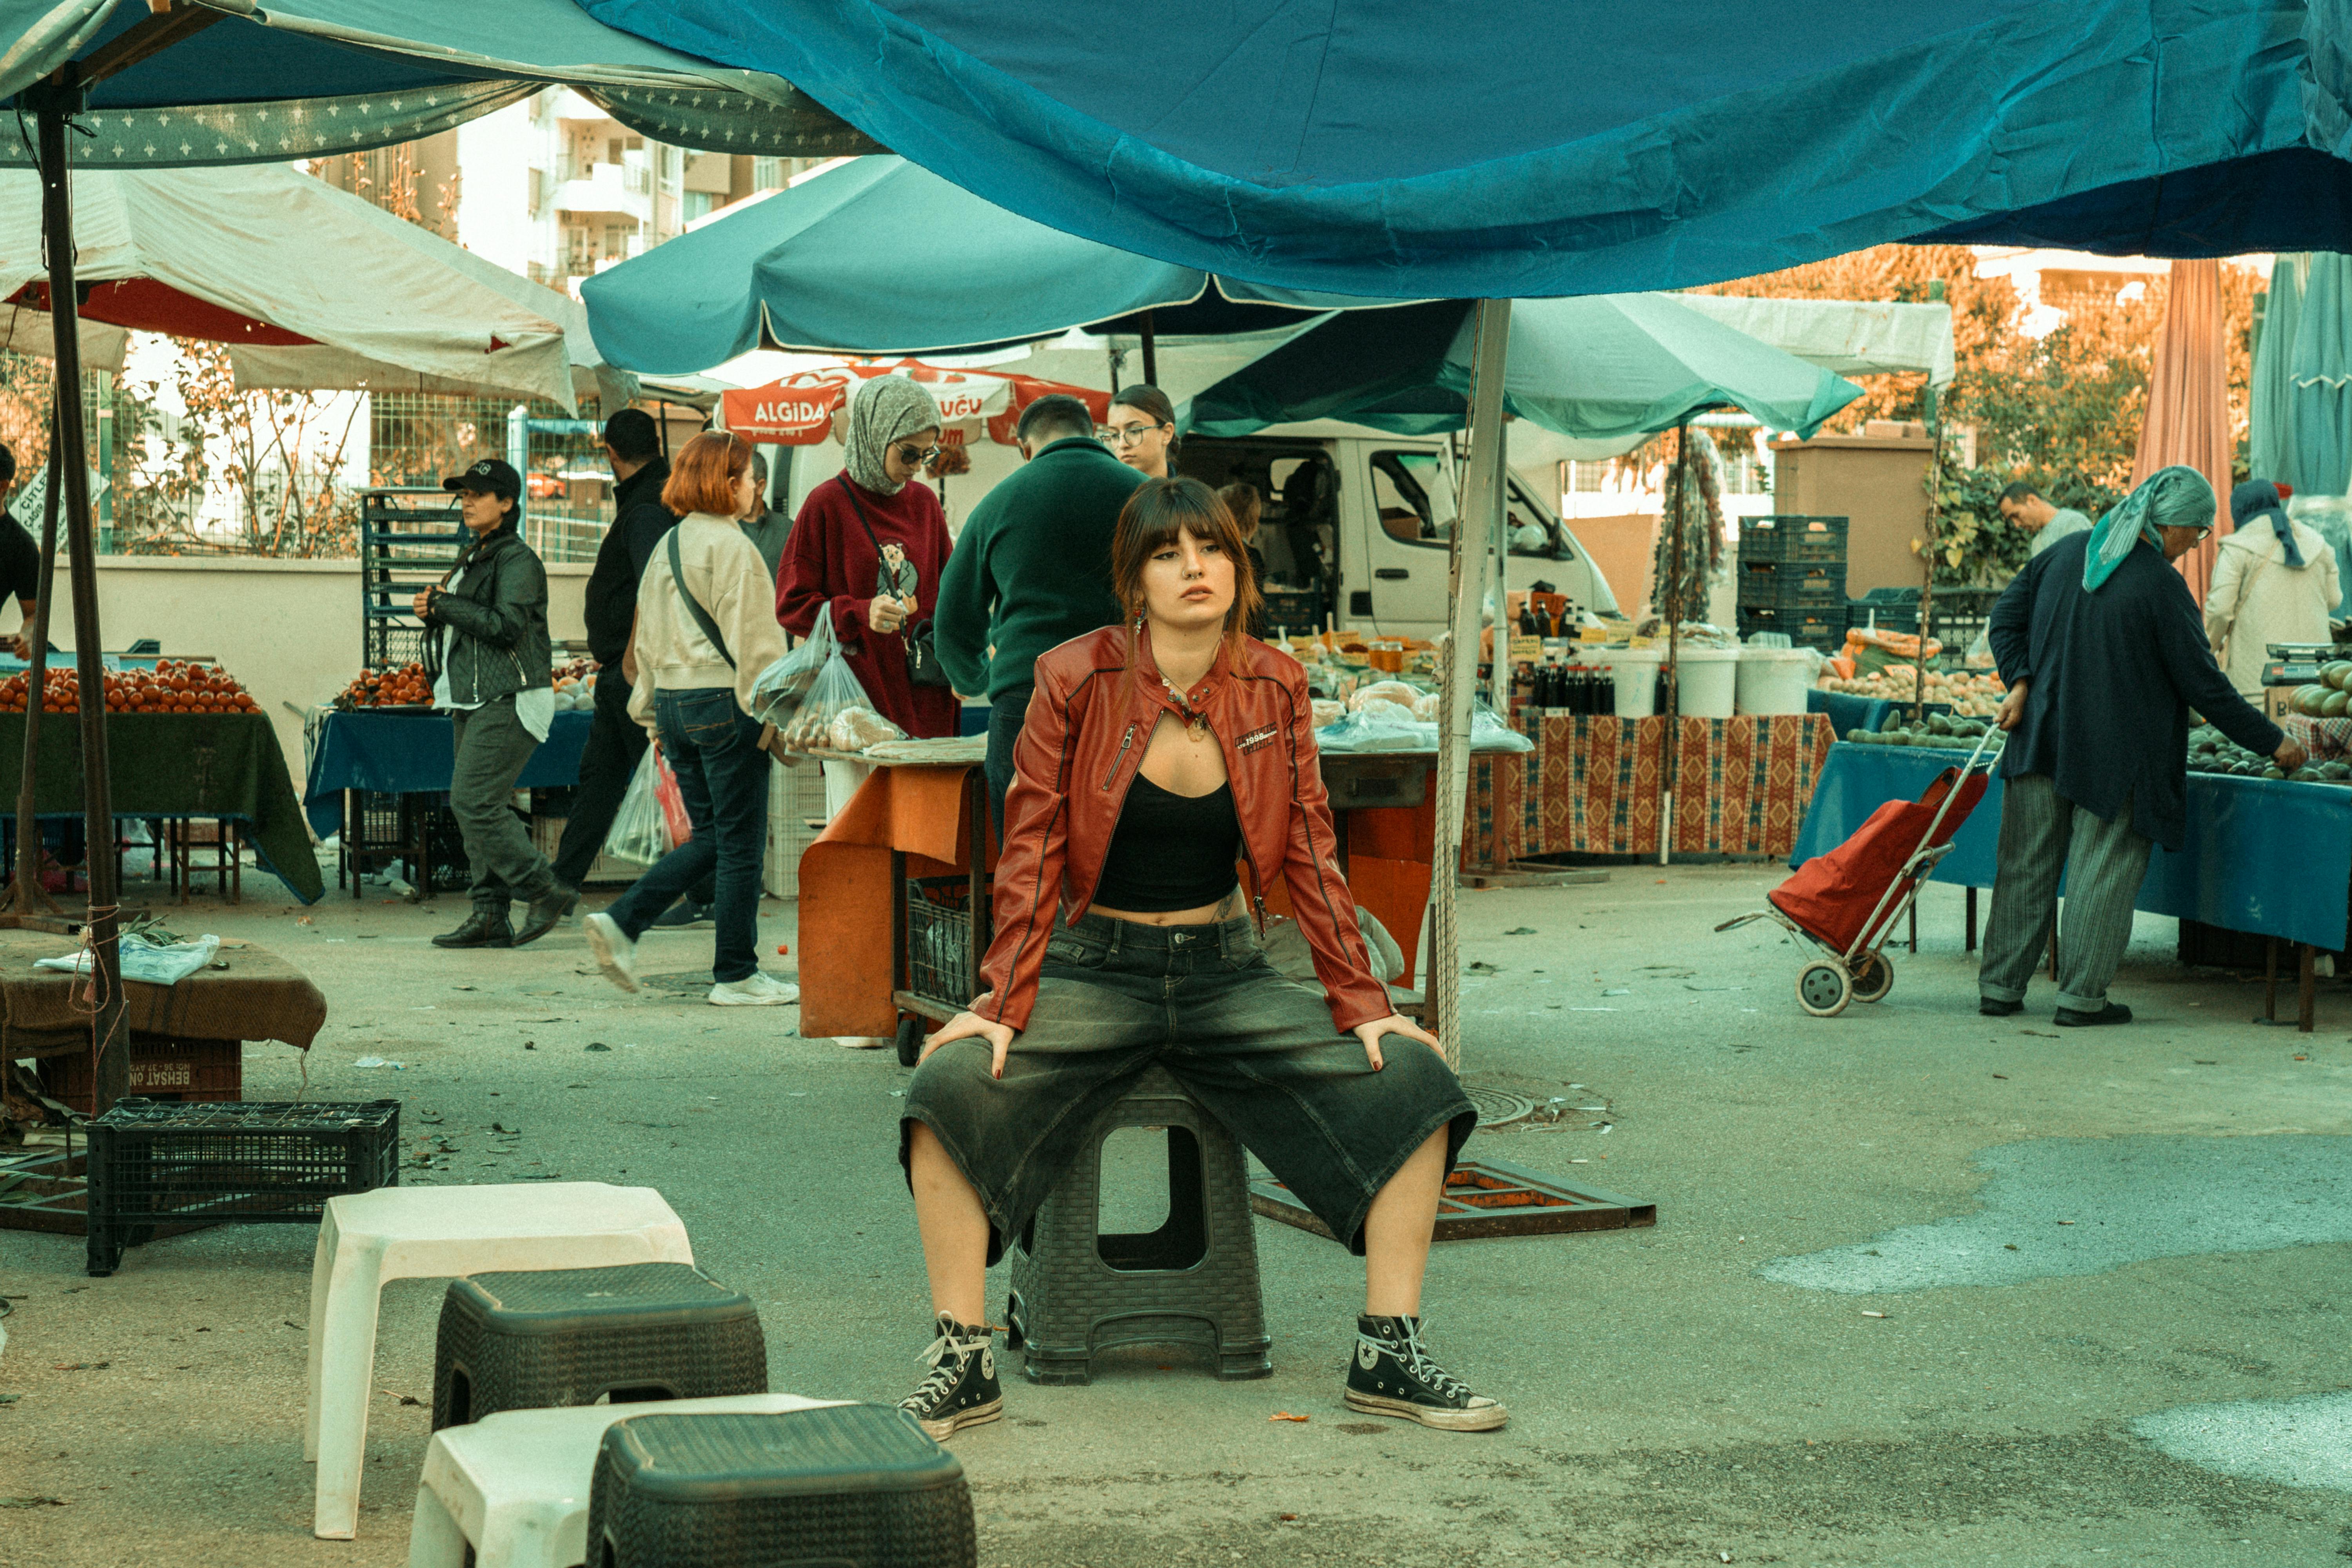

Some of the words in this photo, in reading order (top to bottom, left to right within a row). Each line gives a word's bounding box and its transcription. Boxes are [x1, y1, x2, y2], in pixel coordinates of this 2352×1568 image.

[940, 394, 982, 417] UĞU
[1246, 733, 1264, 746] 1998
[130, 1072, 143, 1086] ÖN
[147, 1071, 190, 1085] BEHSAT
